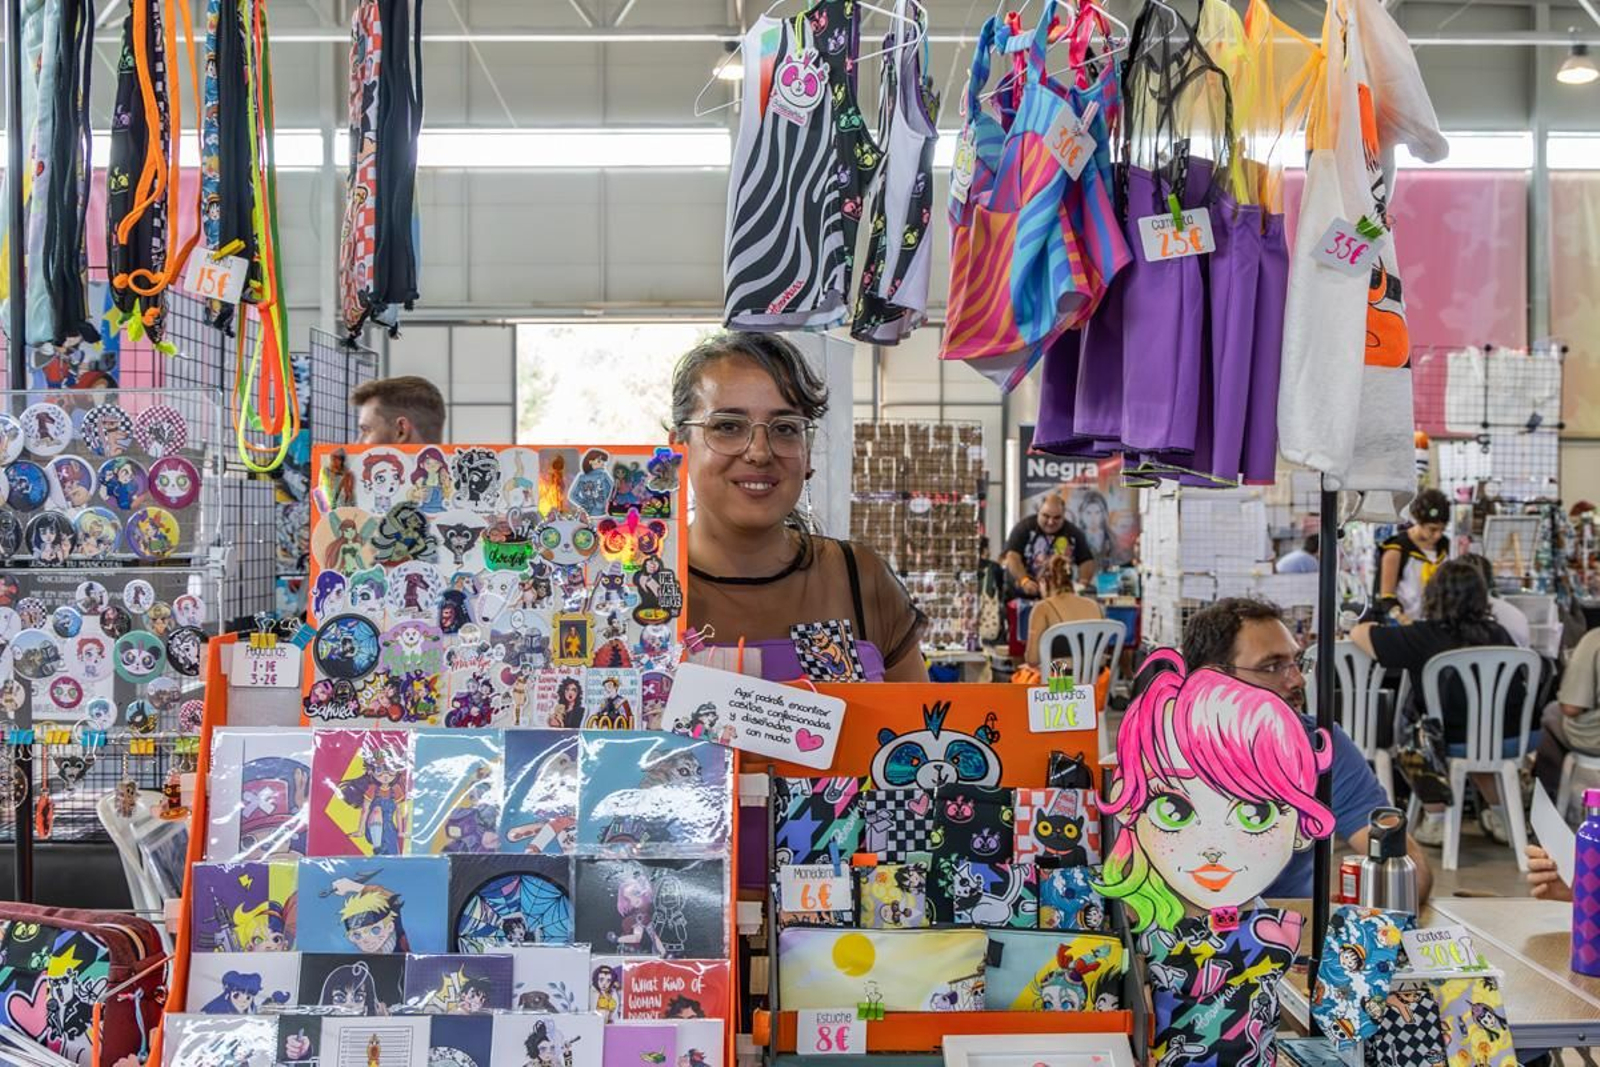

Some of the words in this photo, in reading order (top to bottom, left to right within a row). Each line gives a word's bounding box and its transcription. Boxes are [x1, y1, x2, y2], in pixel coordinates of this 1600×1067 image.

[1156, 226, 1206, 257] 25€
[1325, 231, 1369, 265] 35€
[196, 267, 231, 299] 15€
[1027, 458, 1099, 482] Negra
[734, 688, 754, 700] Aquí
[788, 701, 832, 717] encontrar
[1044, 702, 1080, 729] 12€
[746, 726, 762, 738] con
[765, 731, 792, 745] mucho
[801, 883, 833, 909] 6€
[1416, 941, 1466, 969] 30€
[816, 1011, 853, 1025] Estuche
[816, 1026, 850, 1052] 8€
